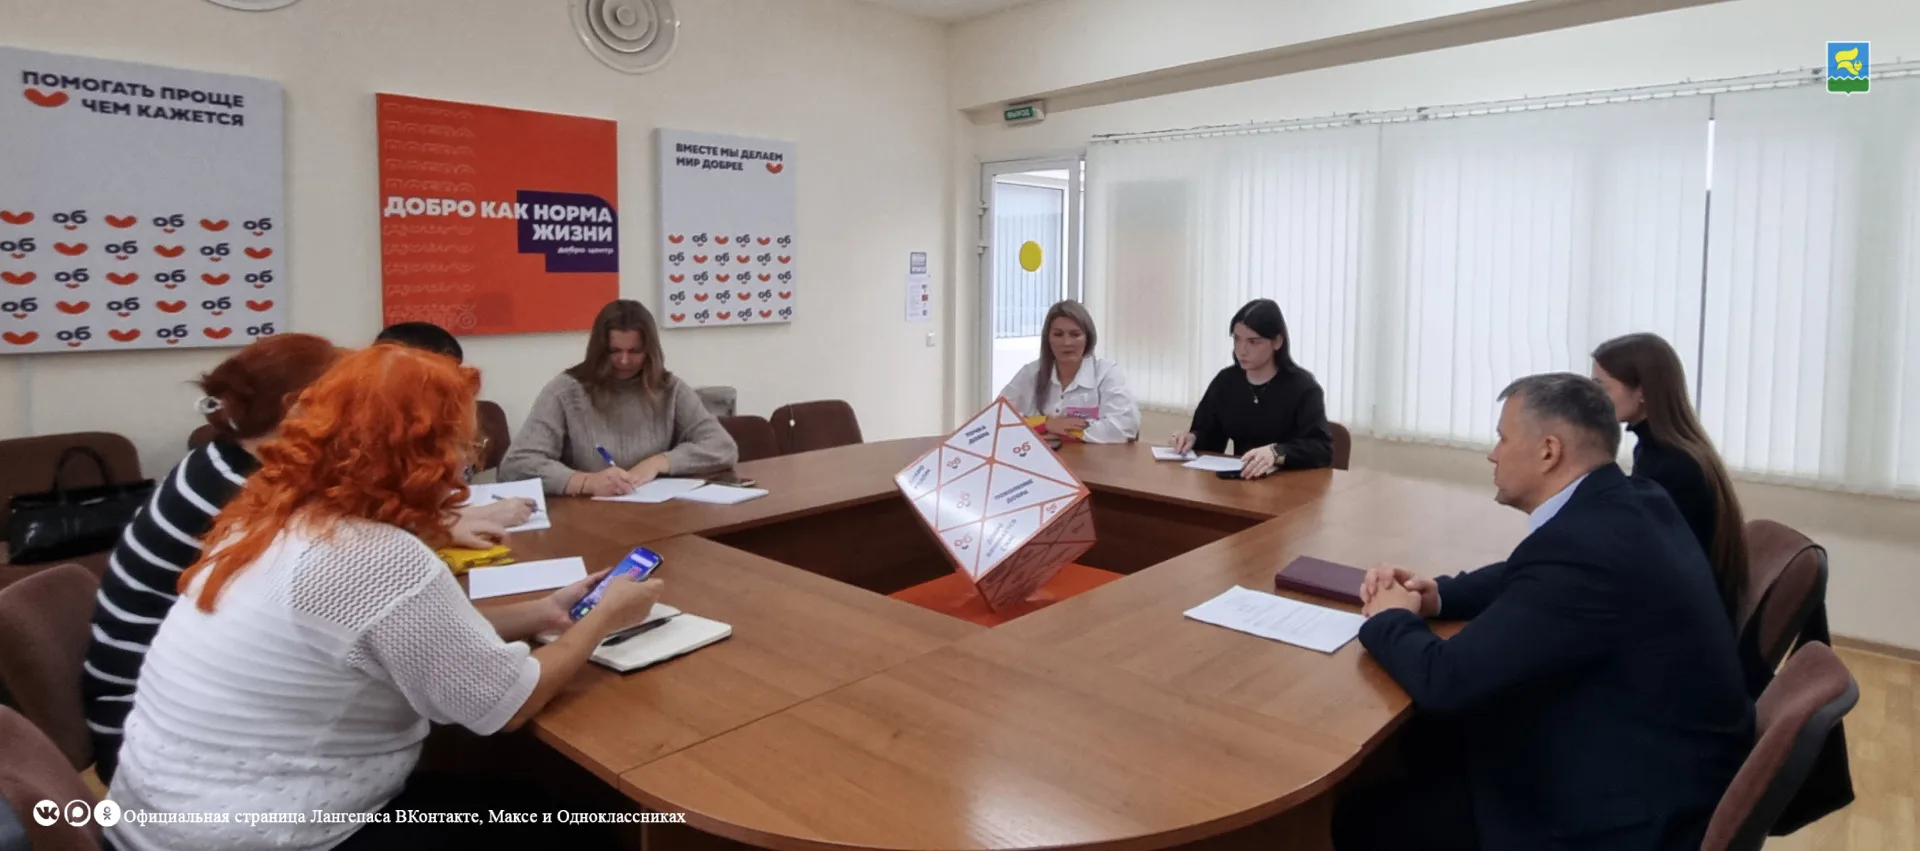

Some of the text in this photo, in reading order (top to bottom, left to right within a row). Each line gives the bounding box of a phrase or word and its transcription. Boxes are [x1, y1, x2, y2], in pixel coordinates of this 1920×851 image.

[22, 70, 244, 108] ПОМОГАТЬ ПРОЩЕ
[82, 98, 244, 127] ЧЕМ КАЖЕТСЯ
[676, 143, 783, 162] ВМЕСТЕ МЫ ДЕЛАЕМ
[676, 156, 743, 171] МИР ДОБРЕЕ
[384, 197, 613, 223] ДОБРО КАК НОРМА
[52, 210, 272, 231] об об об
[532, 224, 613, 242] ЖИЗНИ
[0, 237, 230, 257] об об об
[55, 268, 273, 284] об об об
[1, 297, 231, 313] об об об
[56, 323, 275, 342] об об об
